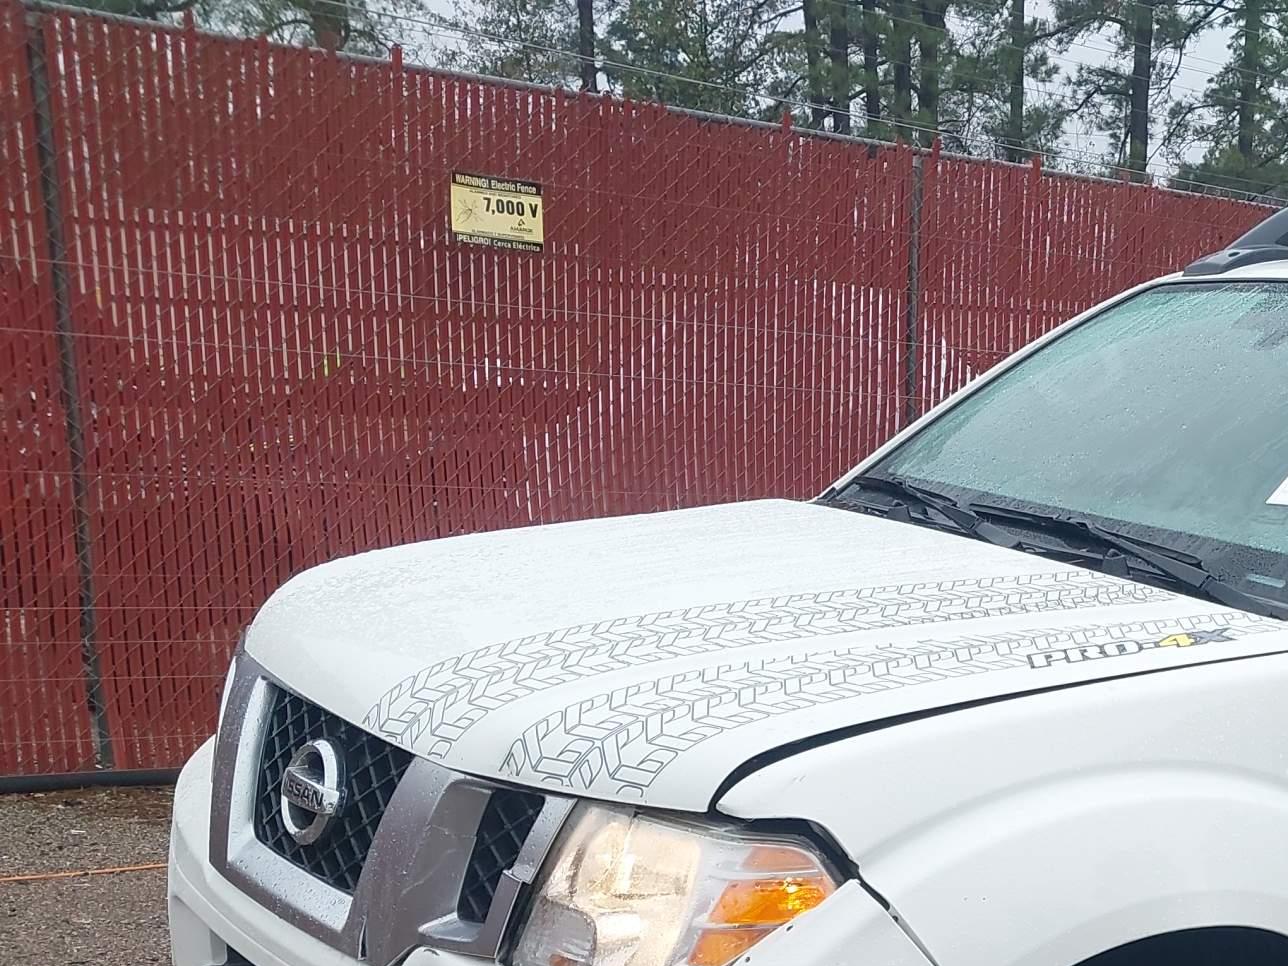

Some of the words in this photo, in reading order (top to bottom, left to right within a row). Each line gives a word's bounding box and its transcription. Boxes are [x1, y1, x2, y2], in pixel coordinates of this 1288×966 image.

[455, 174, 489, 188] WARNING!
[491, 180, 516, 192] Electric
[517, 184, 537, 194] Fence
[483, 197, 525, 217] 7,000
[529, 203, 538, 218] V
[493, 239, 512, 249] Cerca
[512, 241, 541, 252] Eléctrica
[1026, 627, 1238, 669] PRO-4X
[284, 777, 325, 810] ISSAN
